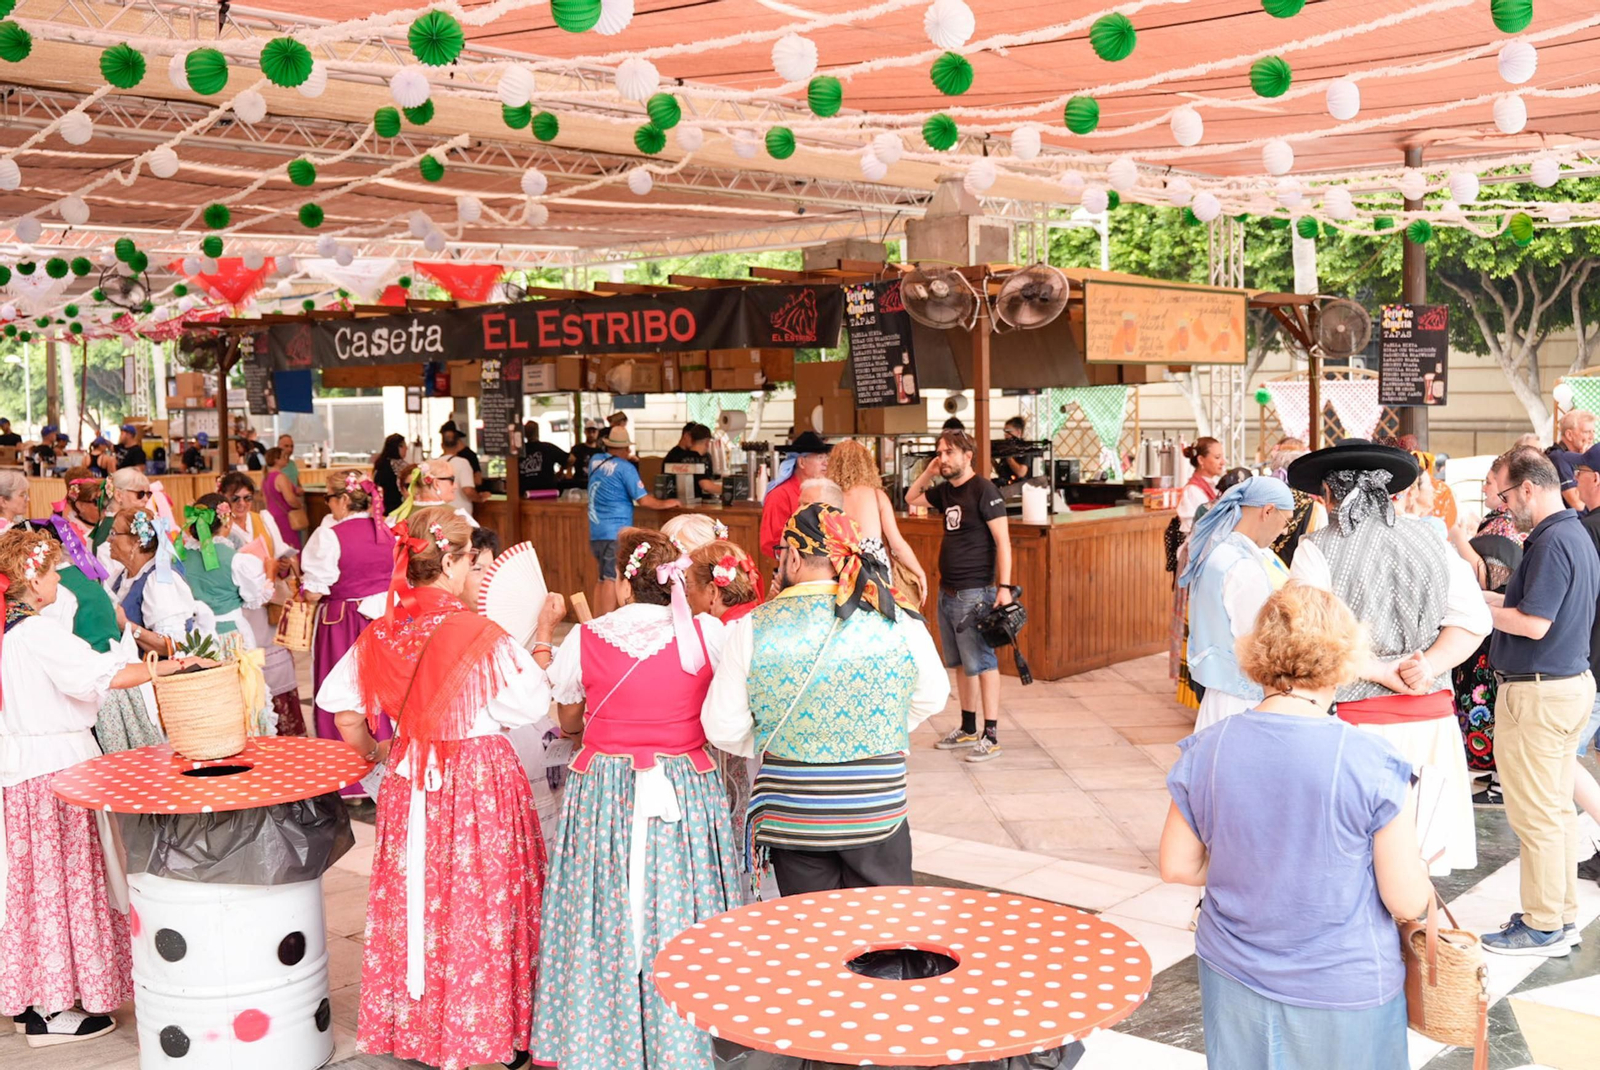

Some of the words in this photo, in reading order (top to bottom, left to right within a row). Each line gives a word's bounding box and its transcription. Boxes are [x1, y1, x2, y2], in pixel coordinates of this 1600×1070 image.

[334, 318, 444, 360] Caseta
[482, 313, 528, 351] EL
[535, 306, 697, 348] ESTRIBO
